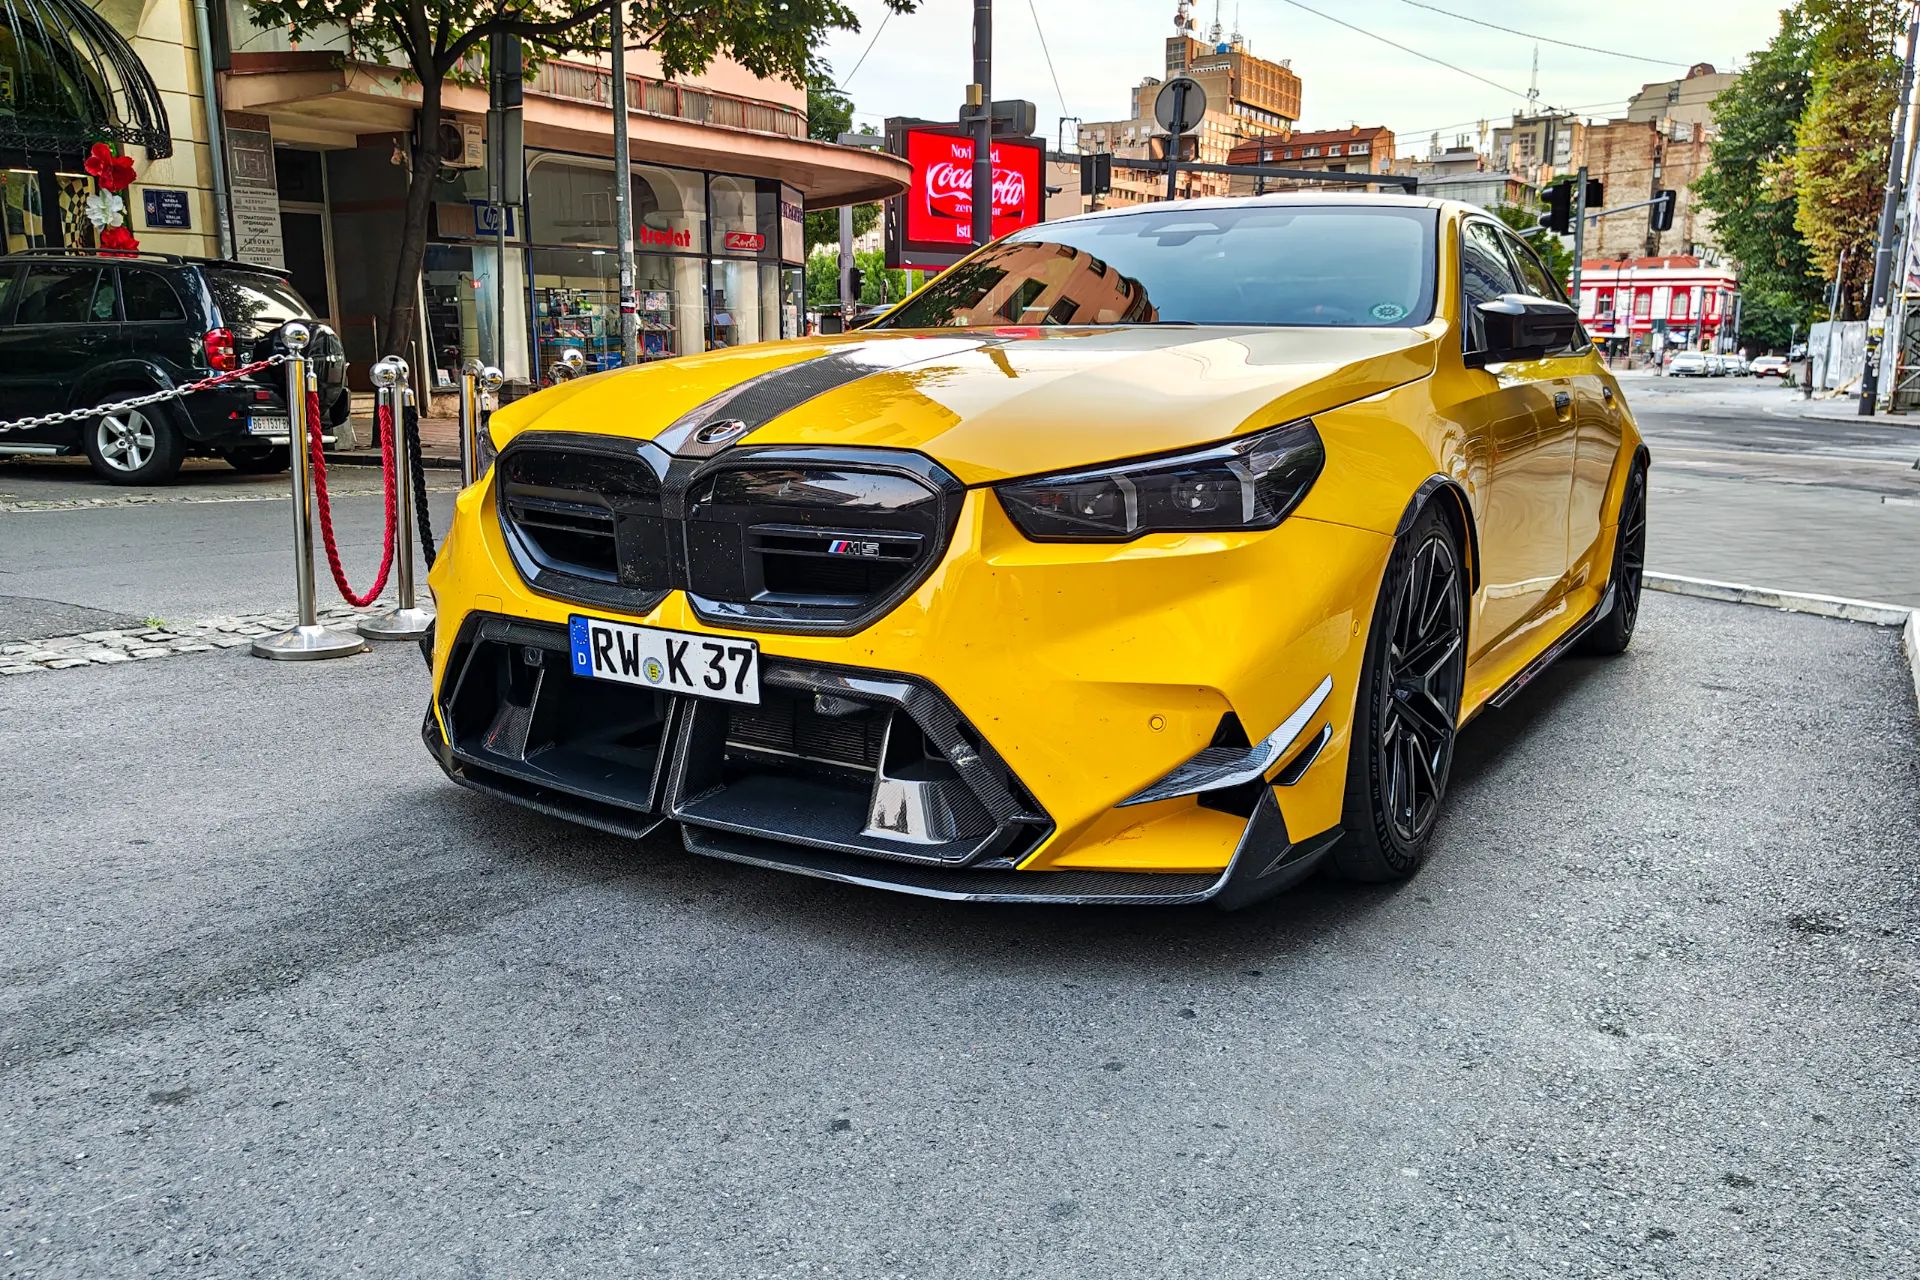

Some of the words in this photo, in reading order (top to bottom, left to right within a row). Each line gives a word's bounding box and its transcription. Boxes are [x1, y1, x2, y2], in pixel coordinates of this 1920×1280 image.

[951, 143, 972, 159] Novi
[926, 162, 1025, 206] Cocaola
[640, 224, 691, 247] trodat
[956, 223, 971, 238] Isti
[253, 418, 262, 429] BG
[844, 540, 880, 557] M5
[577, 652, 587, 666] D
[591, 626, 641, 678] RW
[665, 637, 694, 687] K
[701, 642, 753, 695] 37
